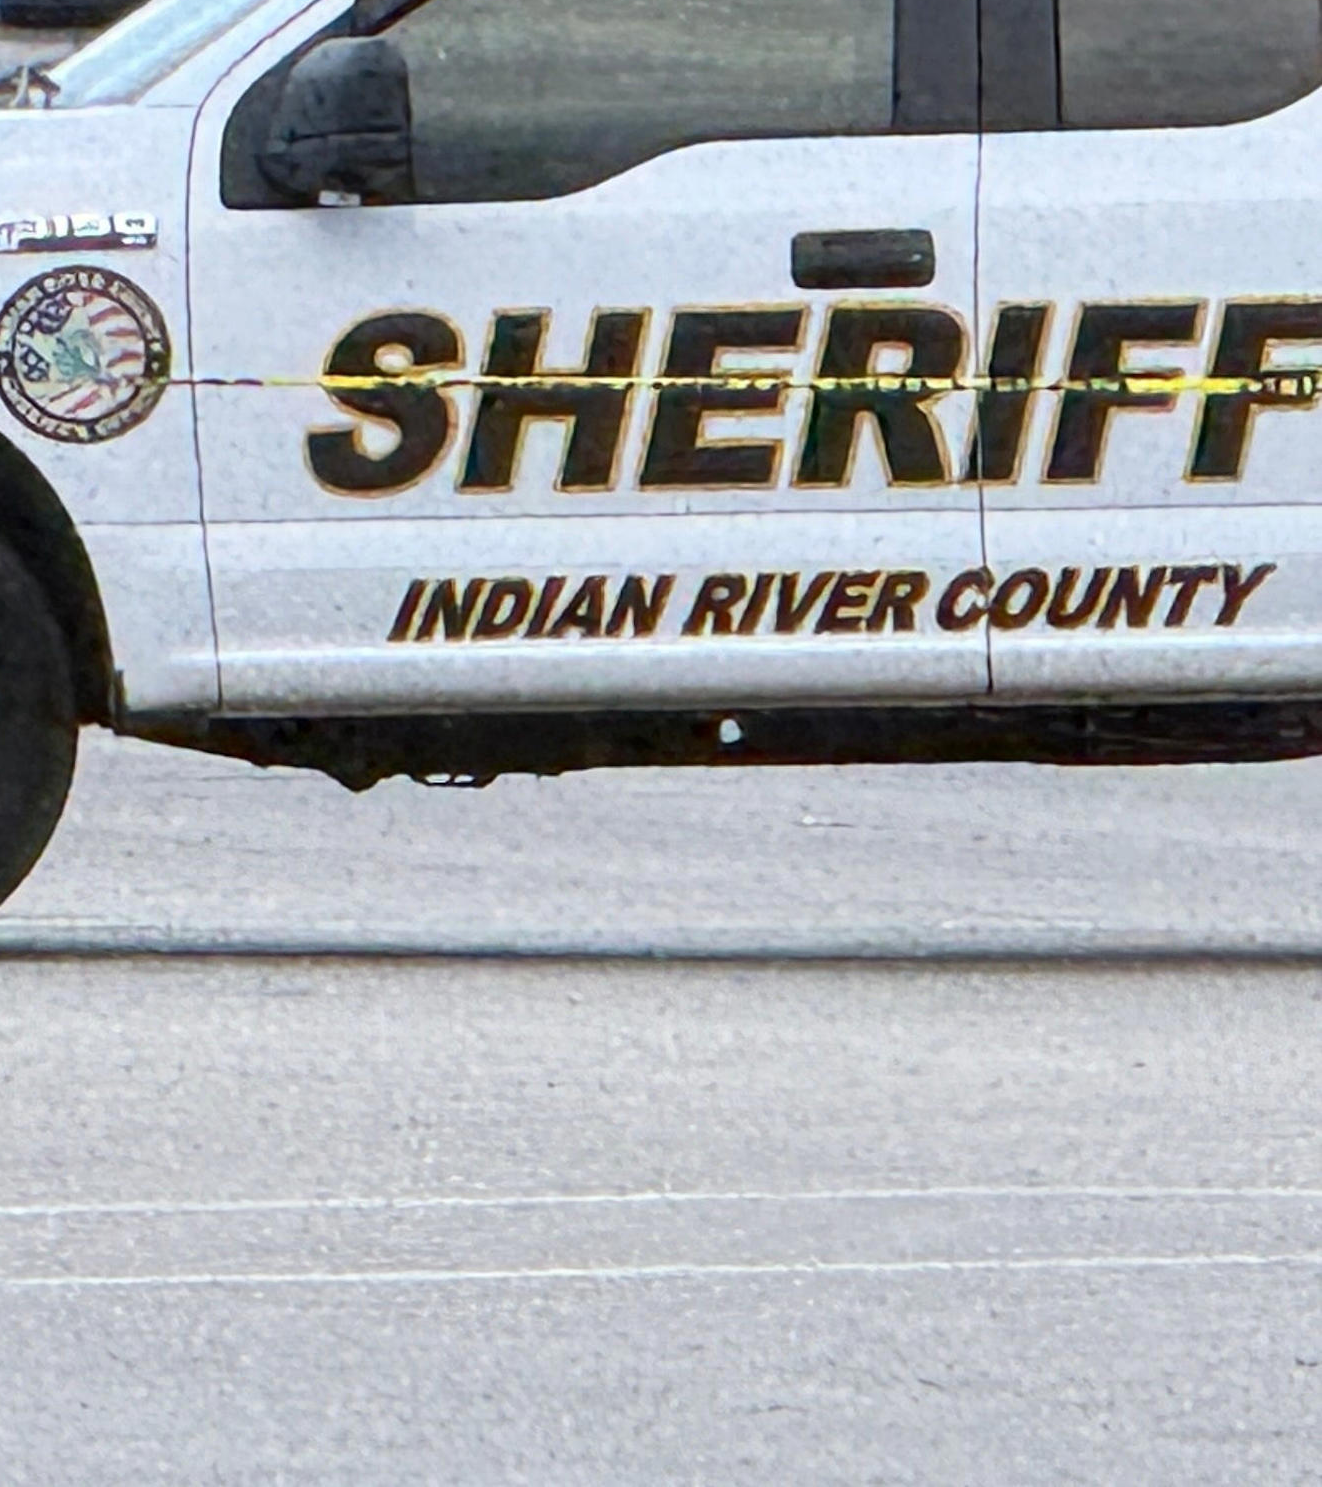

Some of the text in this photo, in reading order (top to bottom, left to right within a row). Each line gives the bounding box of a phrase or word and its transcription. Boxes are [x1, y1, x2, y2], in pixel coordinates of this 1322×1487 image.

[304, 297, 1322, 497] SHERIFF
[387, 563, 1277, 642] INDIAN RIVER COUNTY
